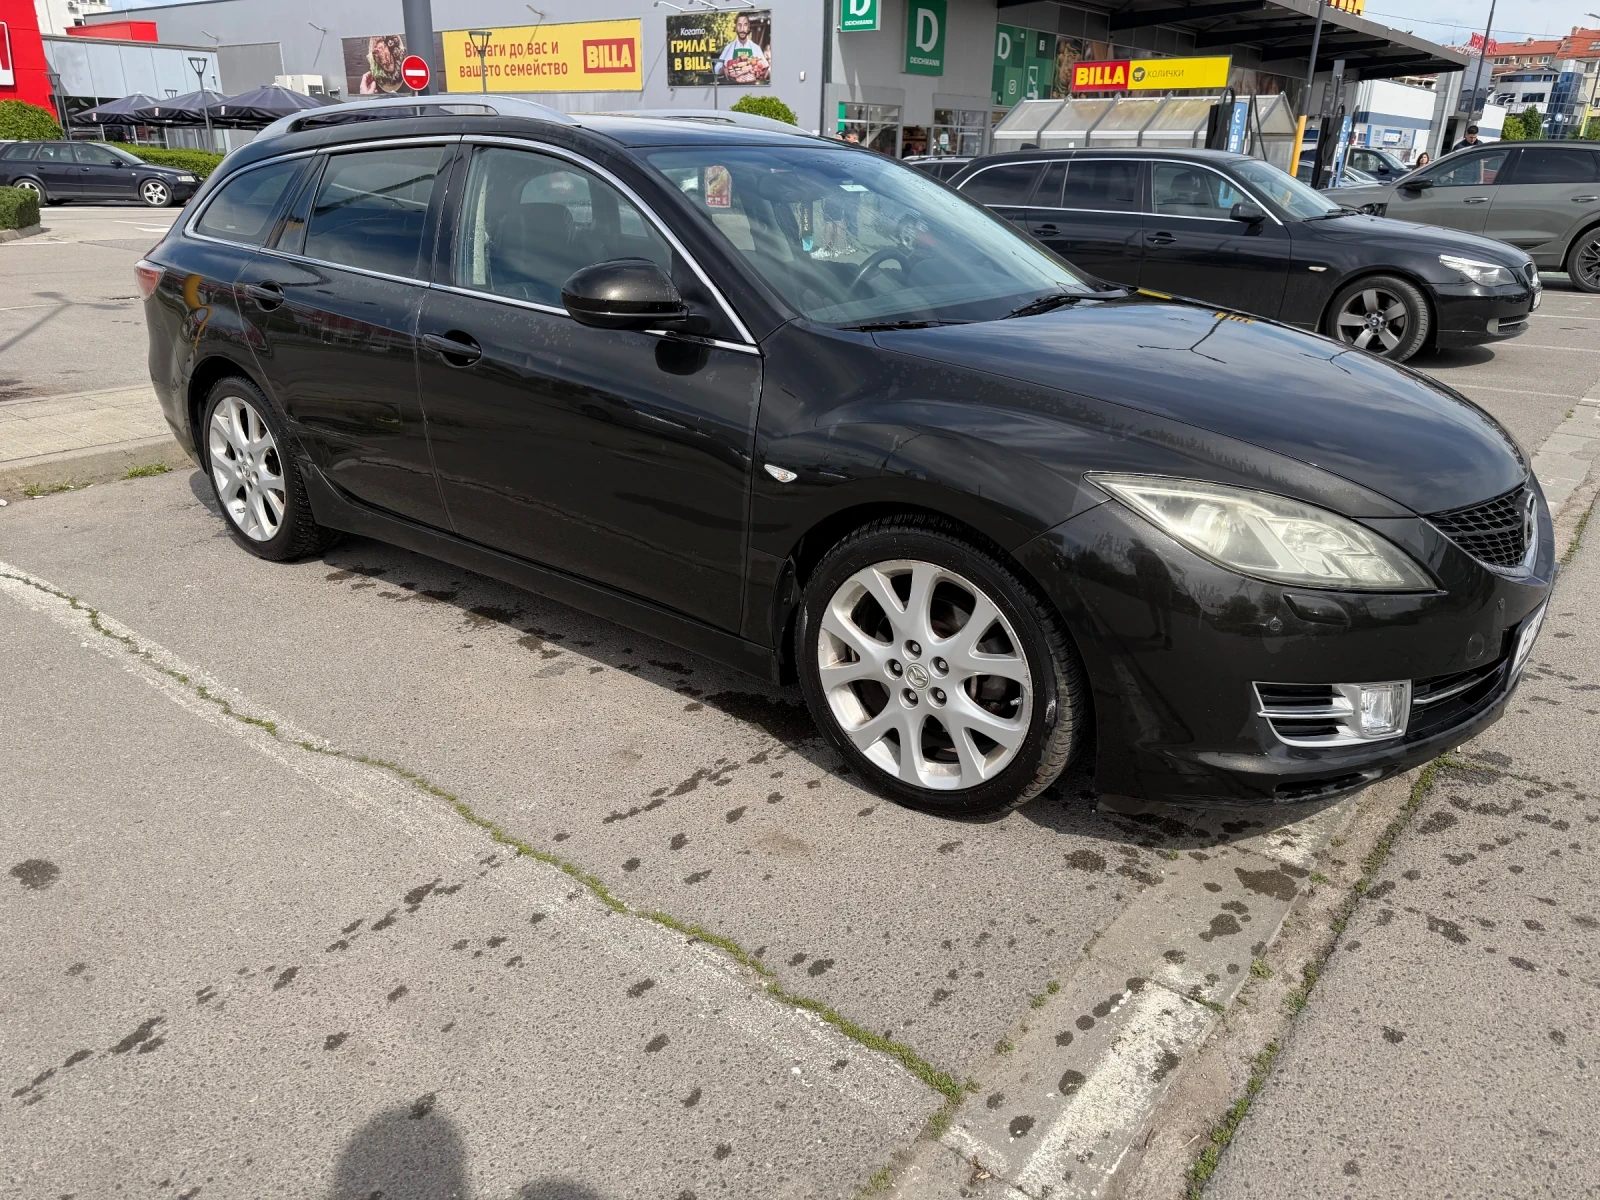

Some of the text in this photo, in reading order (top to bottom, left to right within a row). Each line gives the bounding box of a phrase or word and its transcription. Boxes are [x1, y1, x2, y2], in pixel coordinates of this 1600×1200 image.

[680, 27, 706, 36] Когато
[916, 8, 938, 52] D
[464, 41, 559, 58] Виаги до вас и
[670, 39, 707, 53] ГРИЛА
[586, 44, 632, 69] BILLA
[909, 56, 940, 67] DEICHMANN
[504, 59, 568, 76] семейство
[1075, 66, 1125, 86] BILLA
